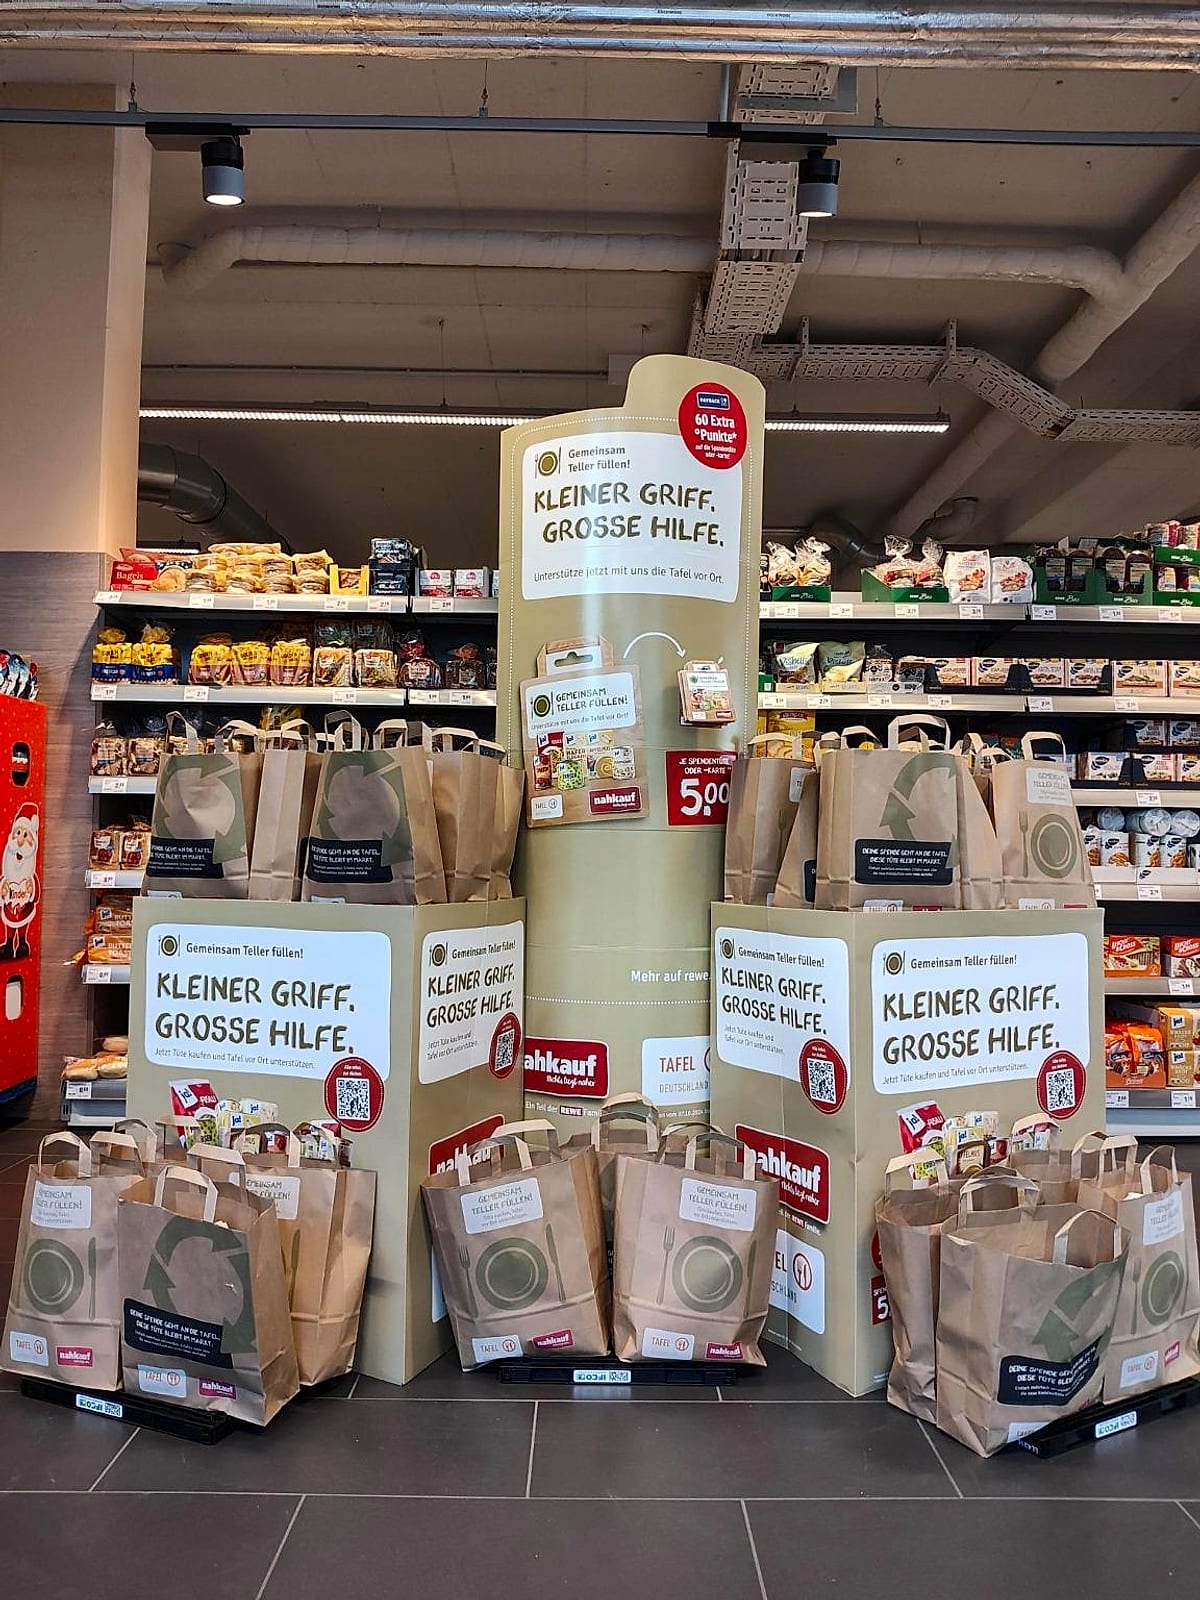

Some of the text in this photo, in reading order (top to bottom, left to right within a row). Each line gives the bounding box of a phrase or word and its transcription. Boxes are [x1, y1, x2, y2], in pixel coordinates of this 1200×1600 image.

[695, 414, 735, 428] 60 Extra
[568, 446, 626, 458] Gemeinsam
[568, 459, 631, 472] Teller füllen!
[534, 482, 716, 512] KLEINER GRIFF.
[542, 515, 724, 547] GROSSE HILFE.
[116, 572, 144, 582] Bagels
[534, 566, 724, 583] Unterstütze jetzt mit uns die Tafel vor Ort.
[556, 688, 606, 702] GEMEINSAM
[557, 695, 628, 712] TELLER FÜLLEN!
[594, 792, 635, 804] nahkauf
[862, 846, 878, 854] DEINE
[880, 847, 900, 855] SPENDE
[186, 943, 304, 958] Gemeinsam Teller füllen!
[452, 946, 486, 959] Gemeinsam
[488, 945, 502, 955] Teller
[738, 947, 825, 968] Gemeinsam Teller füllen!
[911, 954, 1017, 970] Gemeinsam Teller füllen!
[428, 963, 515, 997] KLEINER GRIFF.
[631, 970, 660, 982] Mehr
[664, 970, 682, 982] auf
[157, 972, 355, 1012] KLEINER GRIFF.
[722, 967, 826, 1004] KLEINER GRIFF.
[427, 990, 514, 1028] GROSSE HILFE.
[883, 984, 1060, 1022] KLEINER GRIFF.
[722, 995, 826, 1035] GROSSE HILFE.
[156, 1012, 354, 1054] GROSSE HILFE.
[883, 1023, 1060, 1065] GROSSE HILFE.
[155, 1048, 171, 1056] Jetzt
[188, 1050, 212, 1060] kaufen
[227, 1054, 243, 1062] Tafel
[257, 1056, 269, 1064] Ort
[270, 1058, 314, 1069] unterstützen.
[524, 1049, 597, 1077] ahkauf
[659, 1056, 696, 1072] TAFEL
[883, 1076, 898, 1085] Jetzt
[900, 1074, 913, 1083] Tüte
[914, 1073, 936, 1081] kaufen
[937, 1070, 949, 1079] und
[951, 1068, 965, 1077] Tafel
[978, 1066, 988, 1074] Ort
[989, 1063, 1028, 1073] unterstützen.
[659, 1080, 709, 1094] DEUTSCHLAND
[179, 1087, 193, 1104] ja!
[525, 1102, 582, 1116] Ein Teil der REWE
[232, 1114, 242, 1126] ja!
[906, 1115, 920, 1129] ja!
[958, 1131, 967, 1143] ja!
[437, 1143, 490, 1174] nahkau
[478, 1187, 522, 1204] GEMEINSAM
[696, 1186, 739, 1200] GEMEINSAM
[472, 1192, 533, 1216] TELLER FÜLLEN!
[689, 1194, 747, 1212] TELLER FÜLLEN!
[150, 1325, 163, 1335] TÜTE
[164, 1330, 182, 1340] BLEIBT
[164, 1321, 179, 1330] GEHT
[180, 1325, 189, 1333] AN
[537, 1334, 569, 1346] nahkauf
[652, 1337, 670, 1347] TAFEL
[15, 1339, 91, 1361] TAFEL nahkauf
[1009, 1365, 1028, 1373] DEINE
[1017, 1374, 1055, 1384] DIESE TÜTE
[202, 1382, 233, 1393] nahkauf
